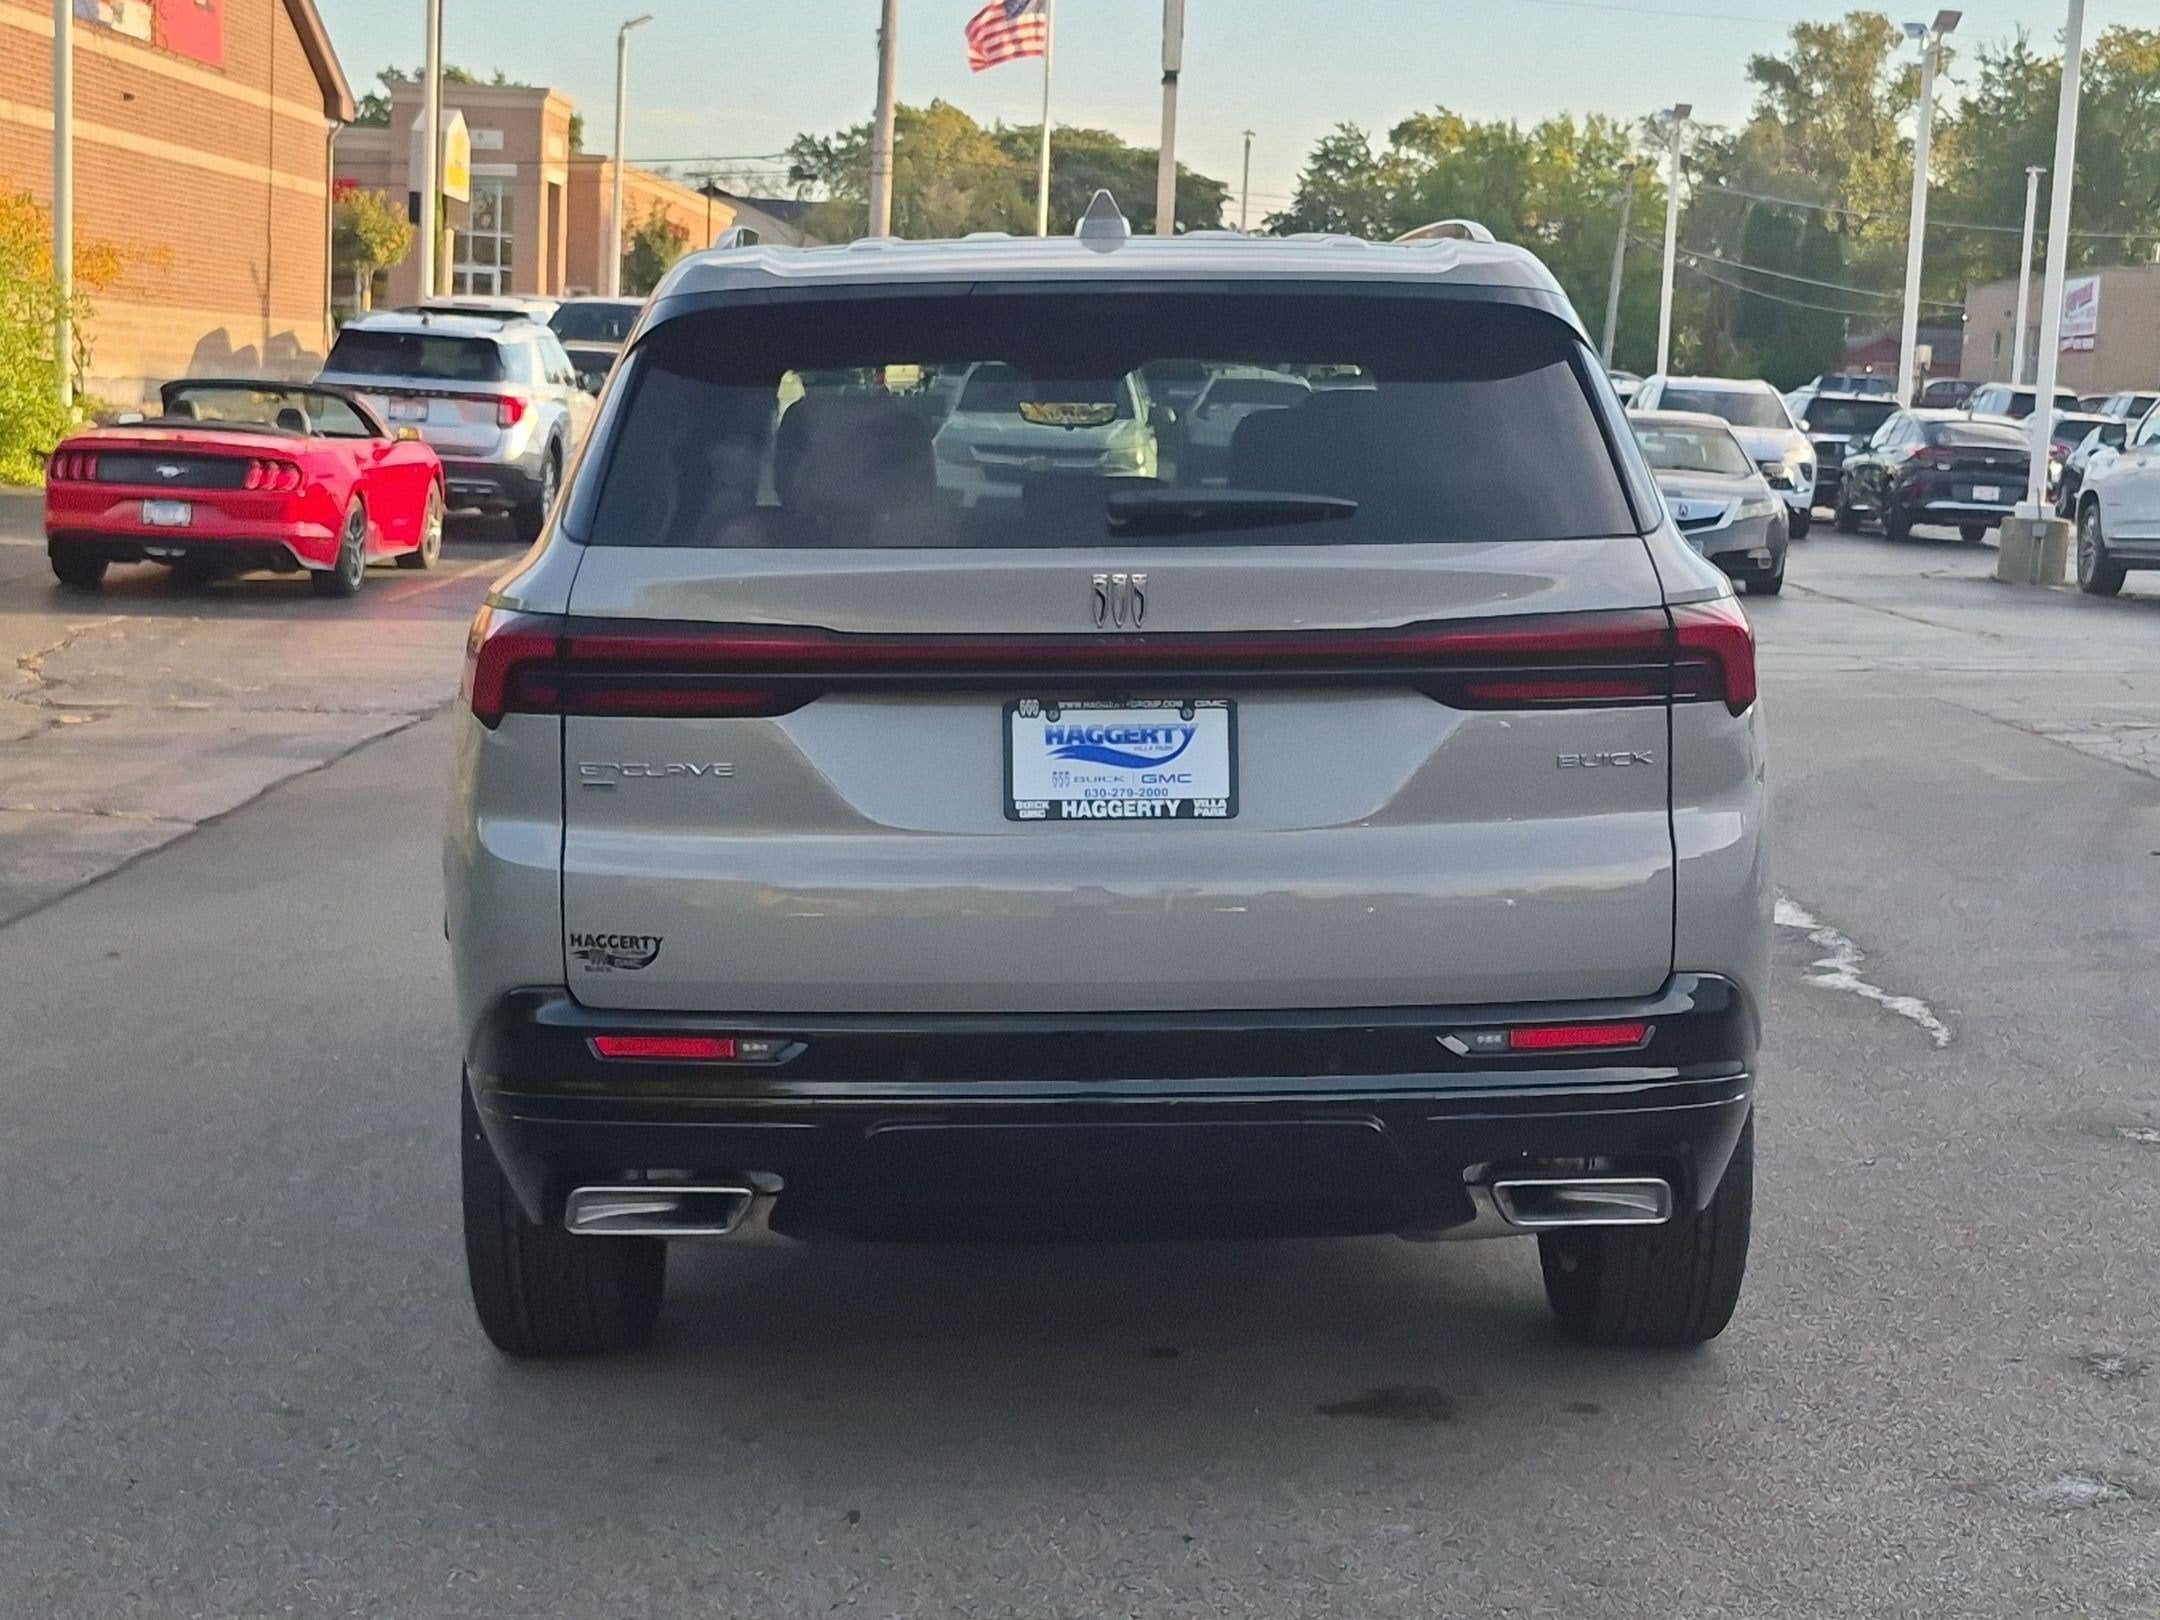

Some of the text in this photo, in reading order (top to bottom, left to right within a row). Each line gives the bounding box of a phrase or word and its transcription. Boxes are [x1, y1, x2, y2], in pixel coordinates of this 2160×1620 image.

[1045, 724, 1199, 746] HAGGERTY
[1557, 750, 1654, 768] BUICK
[1073, 772, 1193, 784] BUICK GMC
[1084, 787, 1169, 798] 630-279-2000
[1061, 800, 1180, 818] HAGGERTY
[569, 933, 664, 950] HAGGERTY
